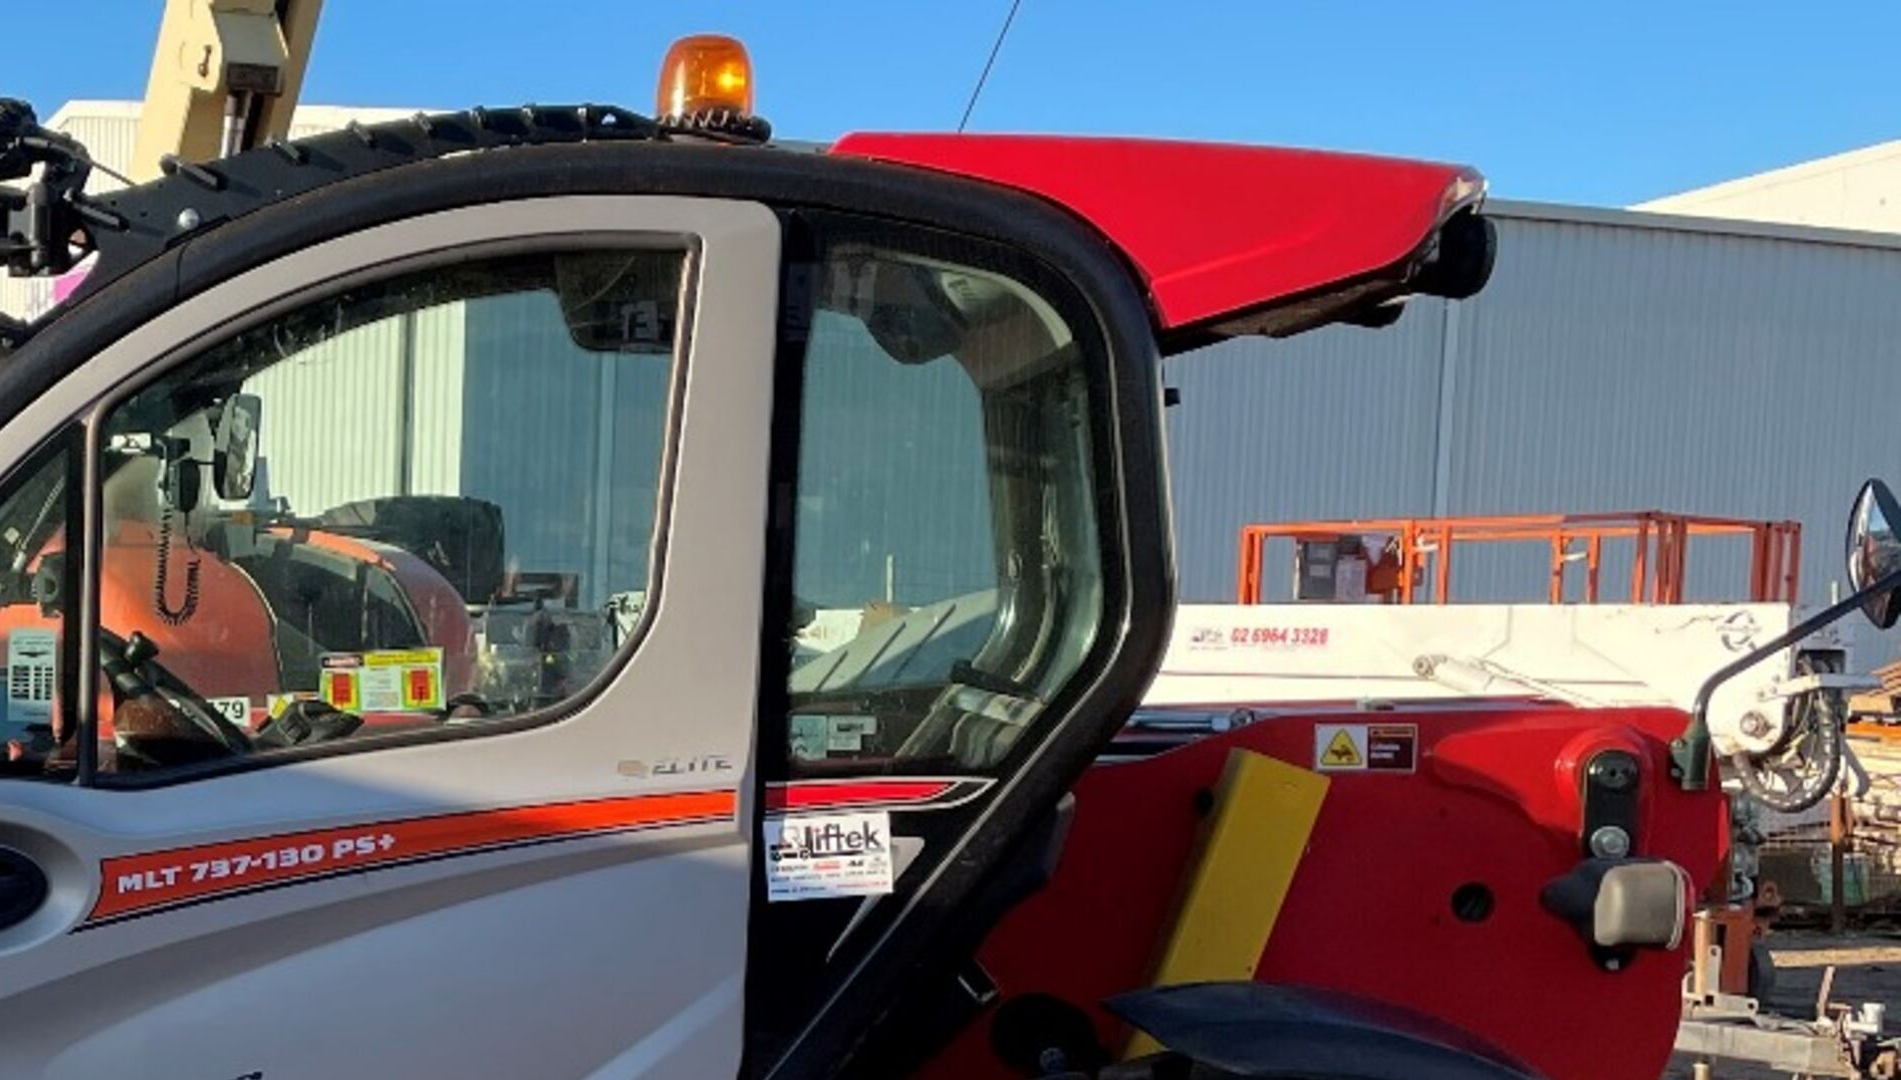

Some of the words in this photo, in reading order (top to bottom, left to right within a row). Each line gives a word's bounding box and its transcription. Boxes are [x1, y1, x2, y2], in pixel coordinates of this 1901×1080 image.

[117, 865, 183, 894] MLT
[190, 844, 324, 883] 737-130
[332, 833, 396, 860] PS+
